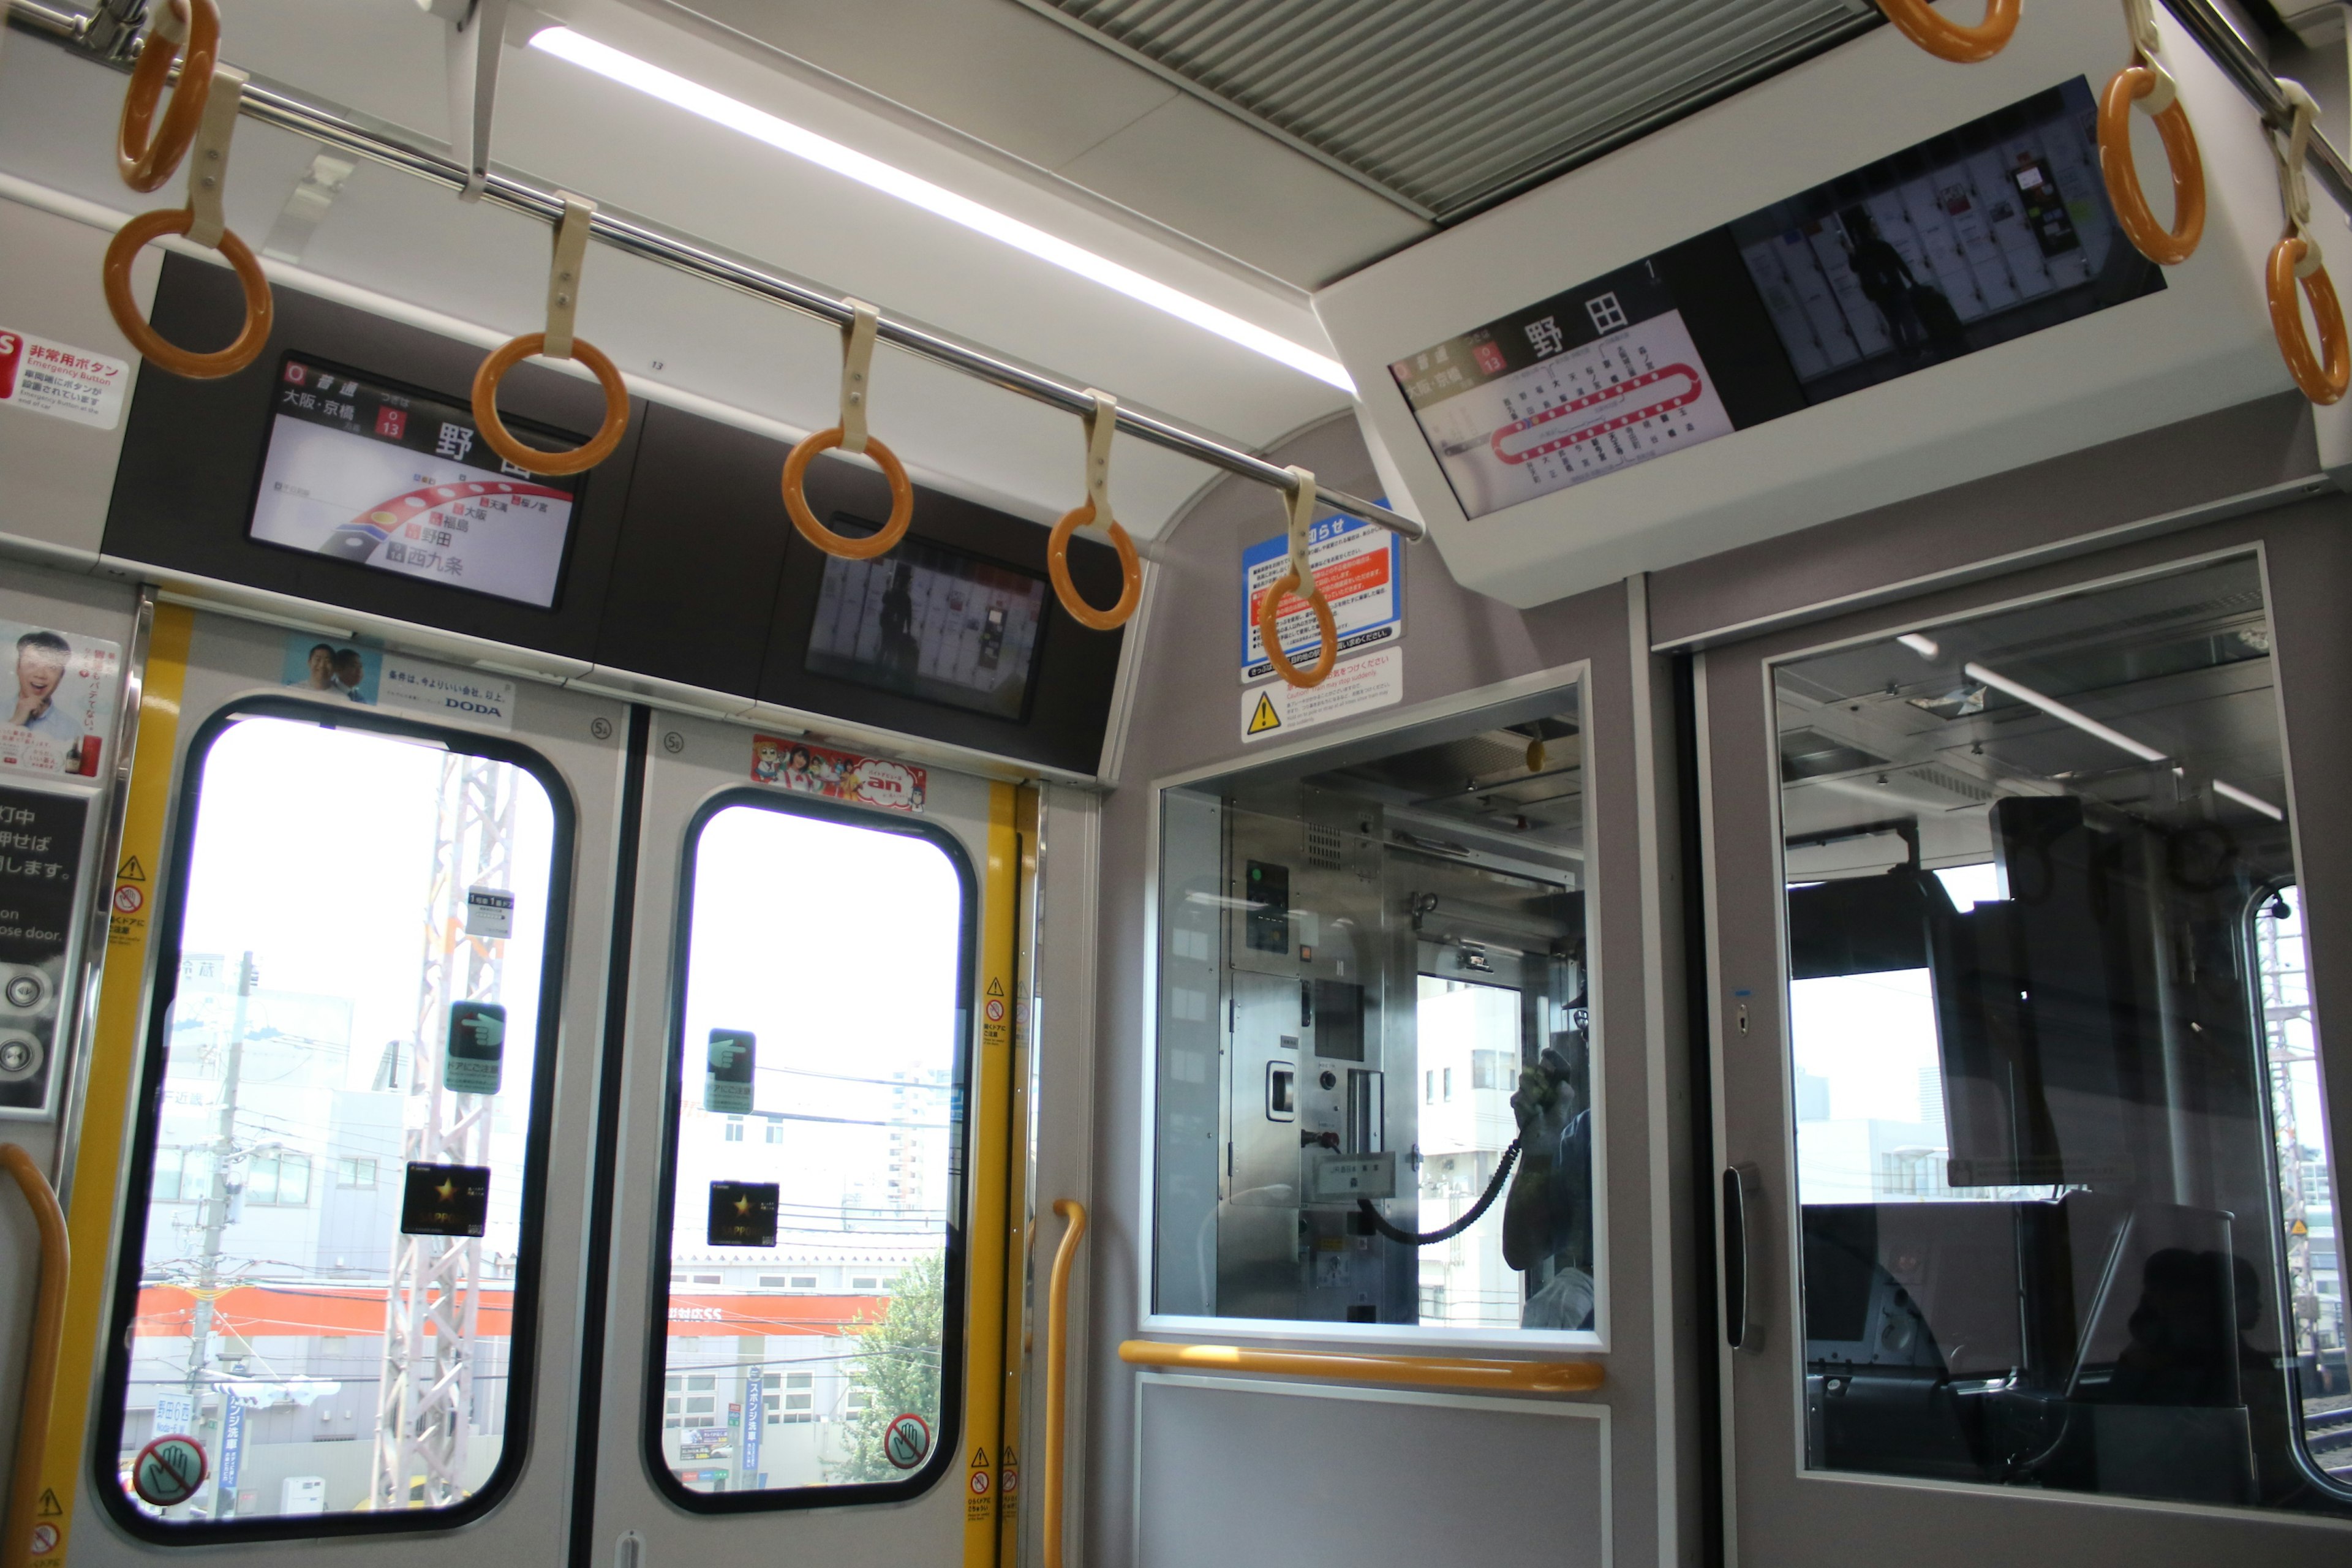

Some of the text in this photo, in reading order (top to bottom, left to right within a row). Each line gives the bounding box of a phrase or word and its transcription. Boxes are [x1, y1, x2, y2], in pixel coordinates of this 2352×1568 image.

[1524, 292, 1629, 359] 野田
[30, 344, 118, 377] 非常用ボタン
[1485, 357, 1501, 371] 13
[27, 357, 111, 386] Emergency Button
[317, 374, 359, 397] 普通
[283, 389, 355, 421] 大阪・京橋
[383, 422, 399, 436] 13
[443, 515, 469, 533] 福島
[464, 507, 487, 521] 大阪
[421, 527, 452, 548] 野田
[407, 547, 463, 576] 西九条
[1311, 684, 1325, 693] Train
[1326, 680, 1338, 690] may
[1338, 676, 1351, 685] stop
[445, 698, 502, 717] DODA
[867, 776, 902, 793] an
[0, 856, 69, 880] します。
[25, 925, 61, 941] door.
[182, 960, 214, 980] 冷蔵
[448, 1061, 499, 1074] ドアにご注意
[157, 1400, 190, 1422] 野田6西
[747, 1382, 759, 1442] スポンジ洗車
